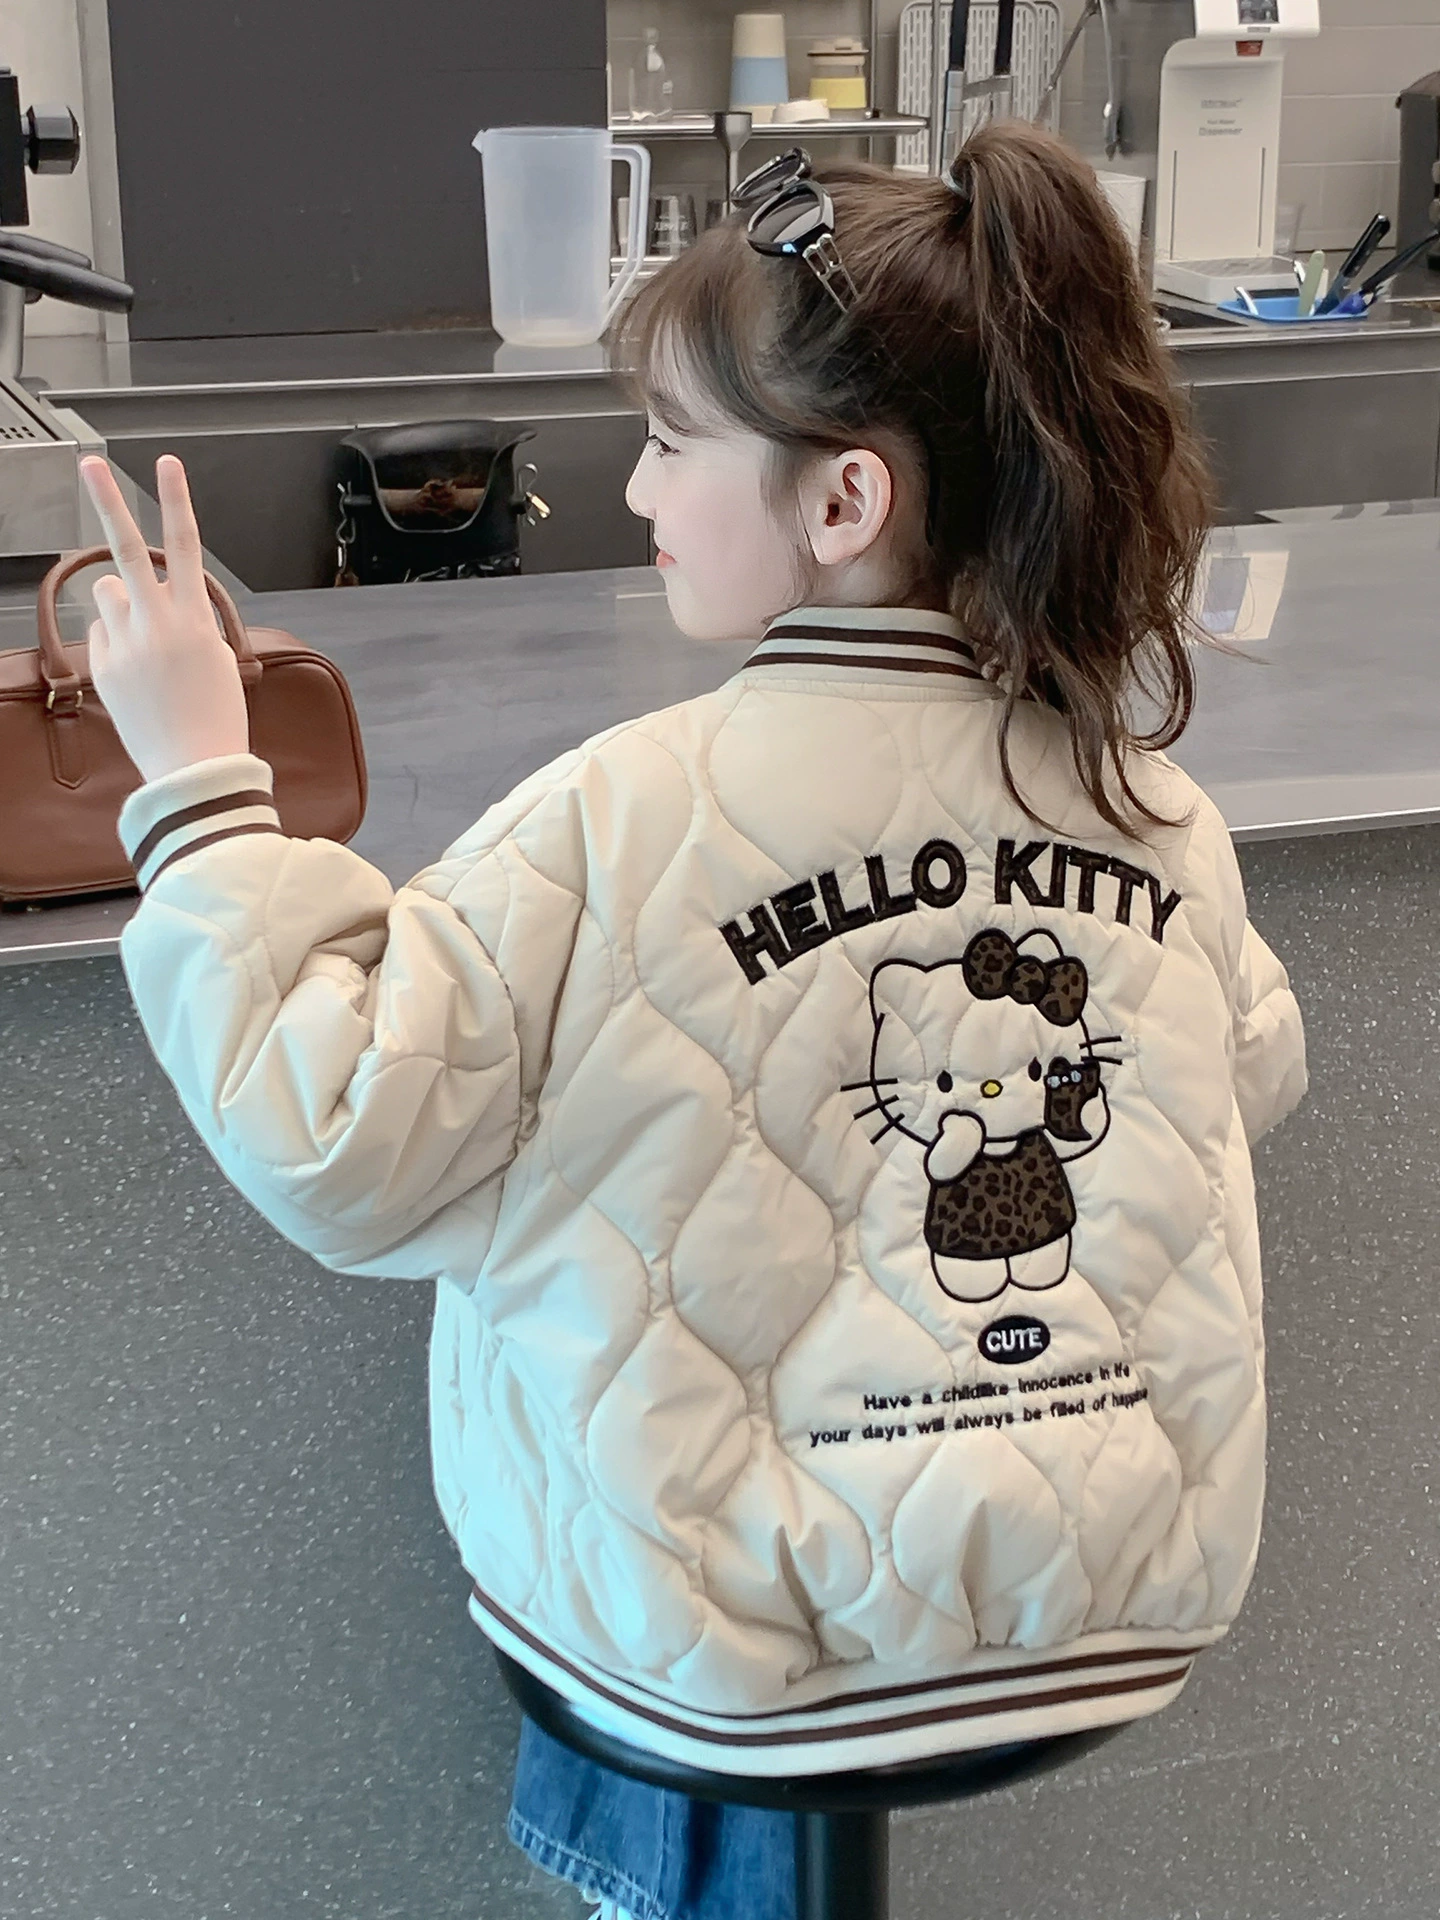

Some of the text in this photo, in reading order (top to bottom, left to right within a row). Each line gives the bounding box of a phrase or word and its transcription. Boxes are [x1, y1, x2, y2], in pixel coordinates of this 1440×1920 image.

[718, 837, 1182, 985] HELLO KITTY
[986, 1327, 1043, 1353] CUTE
[809, 1429, 851, 1448] your
[861, 1424, 907, 1442] days
[954, 1411, 1015, 1430] always
[1023, 1407, 1042, 1422] be
[1092, 1393, 1106, 1412] of
[863, 1394, 912, 1410] Have
